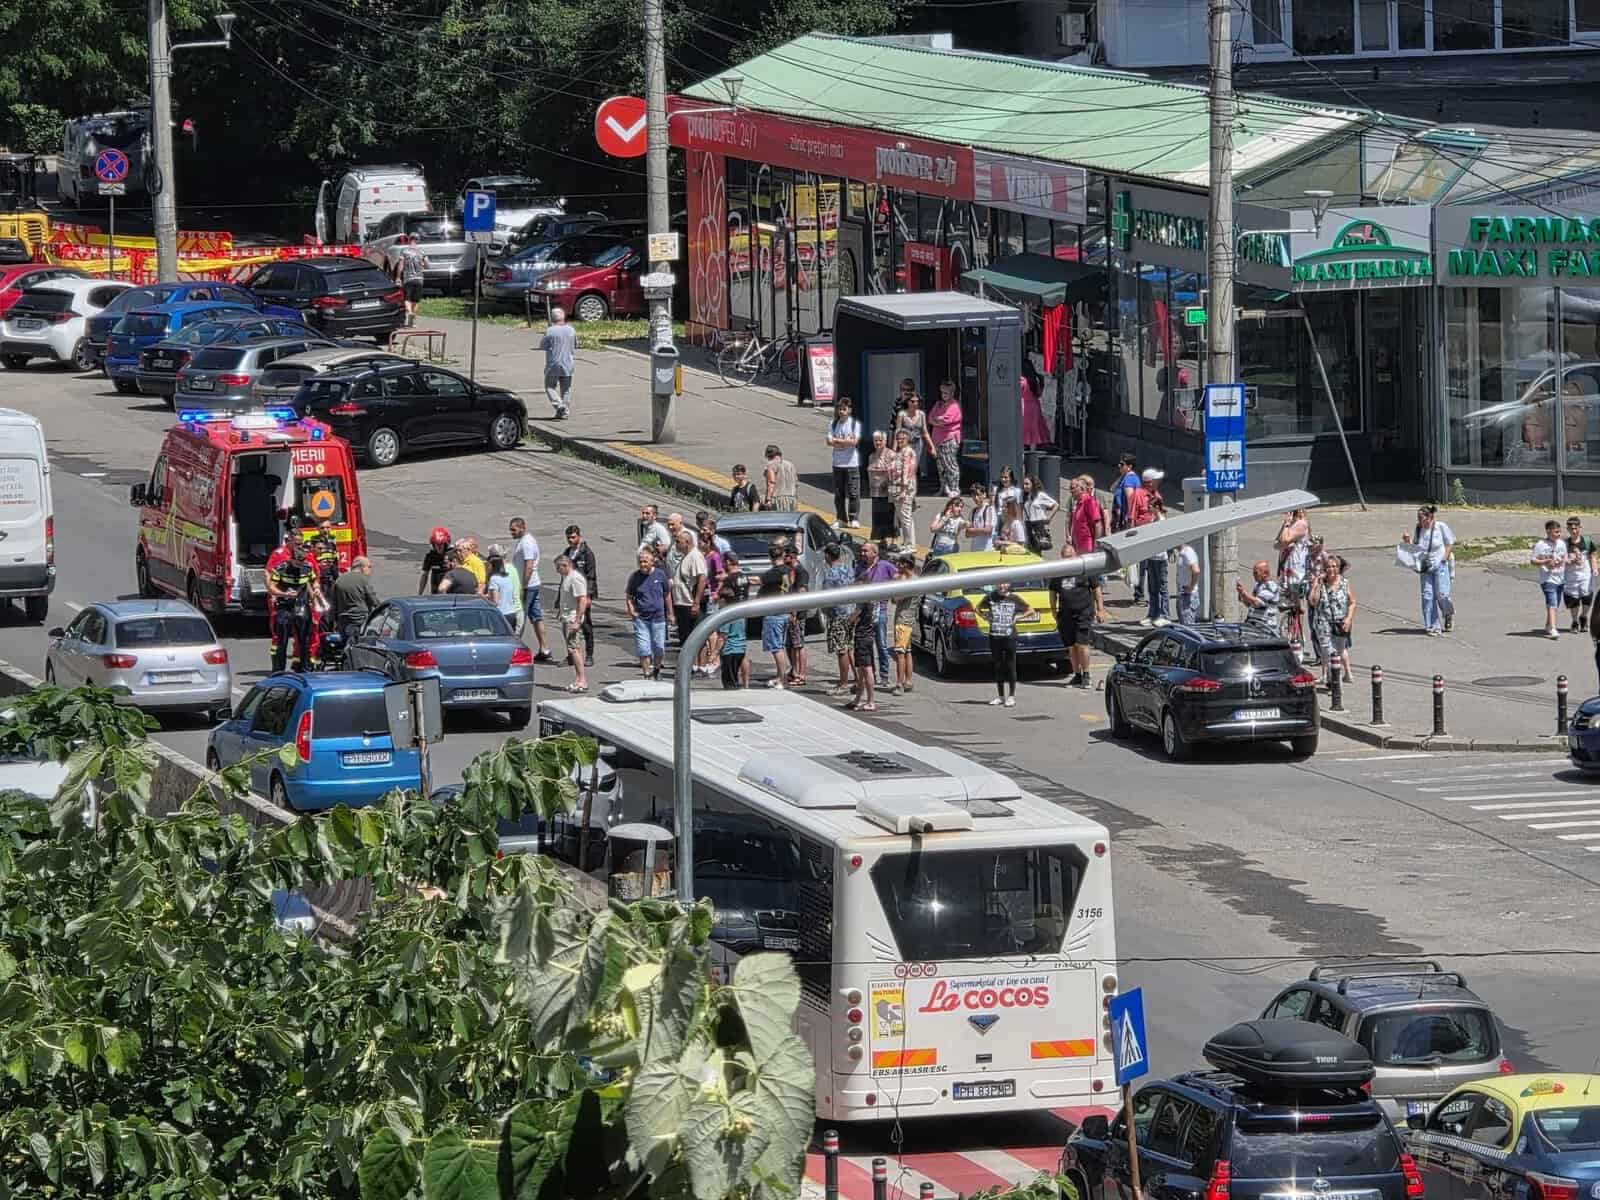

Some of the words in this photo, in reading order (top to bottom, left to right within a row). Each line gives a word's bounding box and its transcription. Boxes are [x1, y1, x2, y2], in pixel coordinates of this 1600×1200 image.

[472, 193, 491, 218] P
[1293, 262, 1354, 283] MAXI
[1356, 256, 1432, 279] FARMA
[1448, 250, 1538, 277] MAXI
[1214, 471, 1238, 480] TAXI
[1077, 907, 1103, 919] 3156
